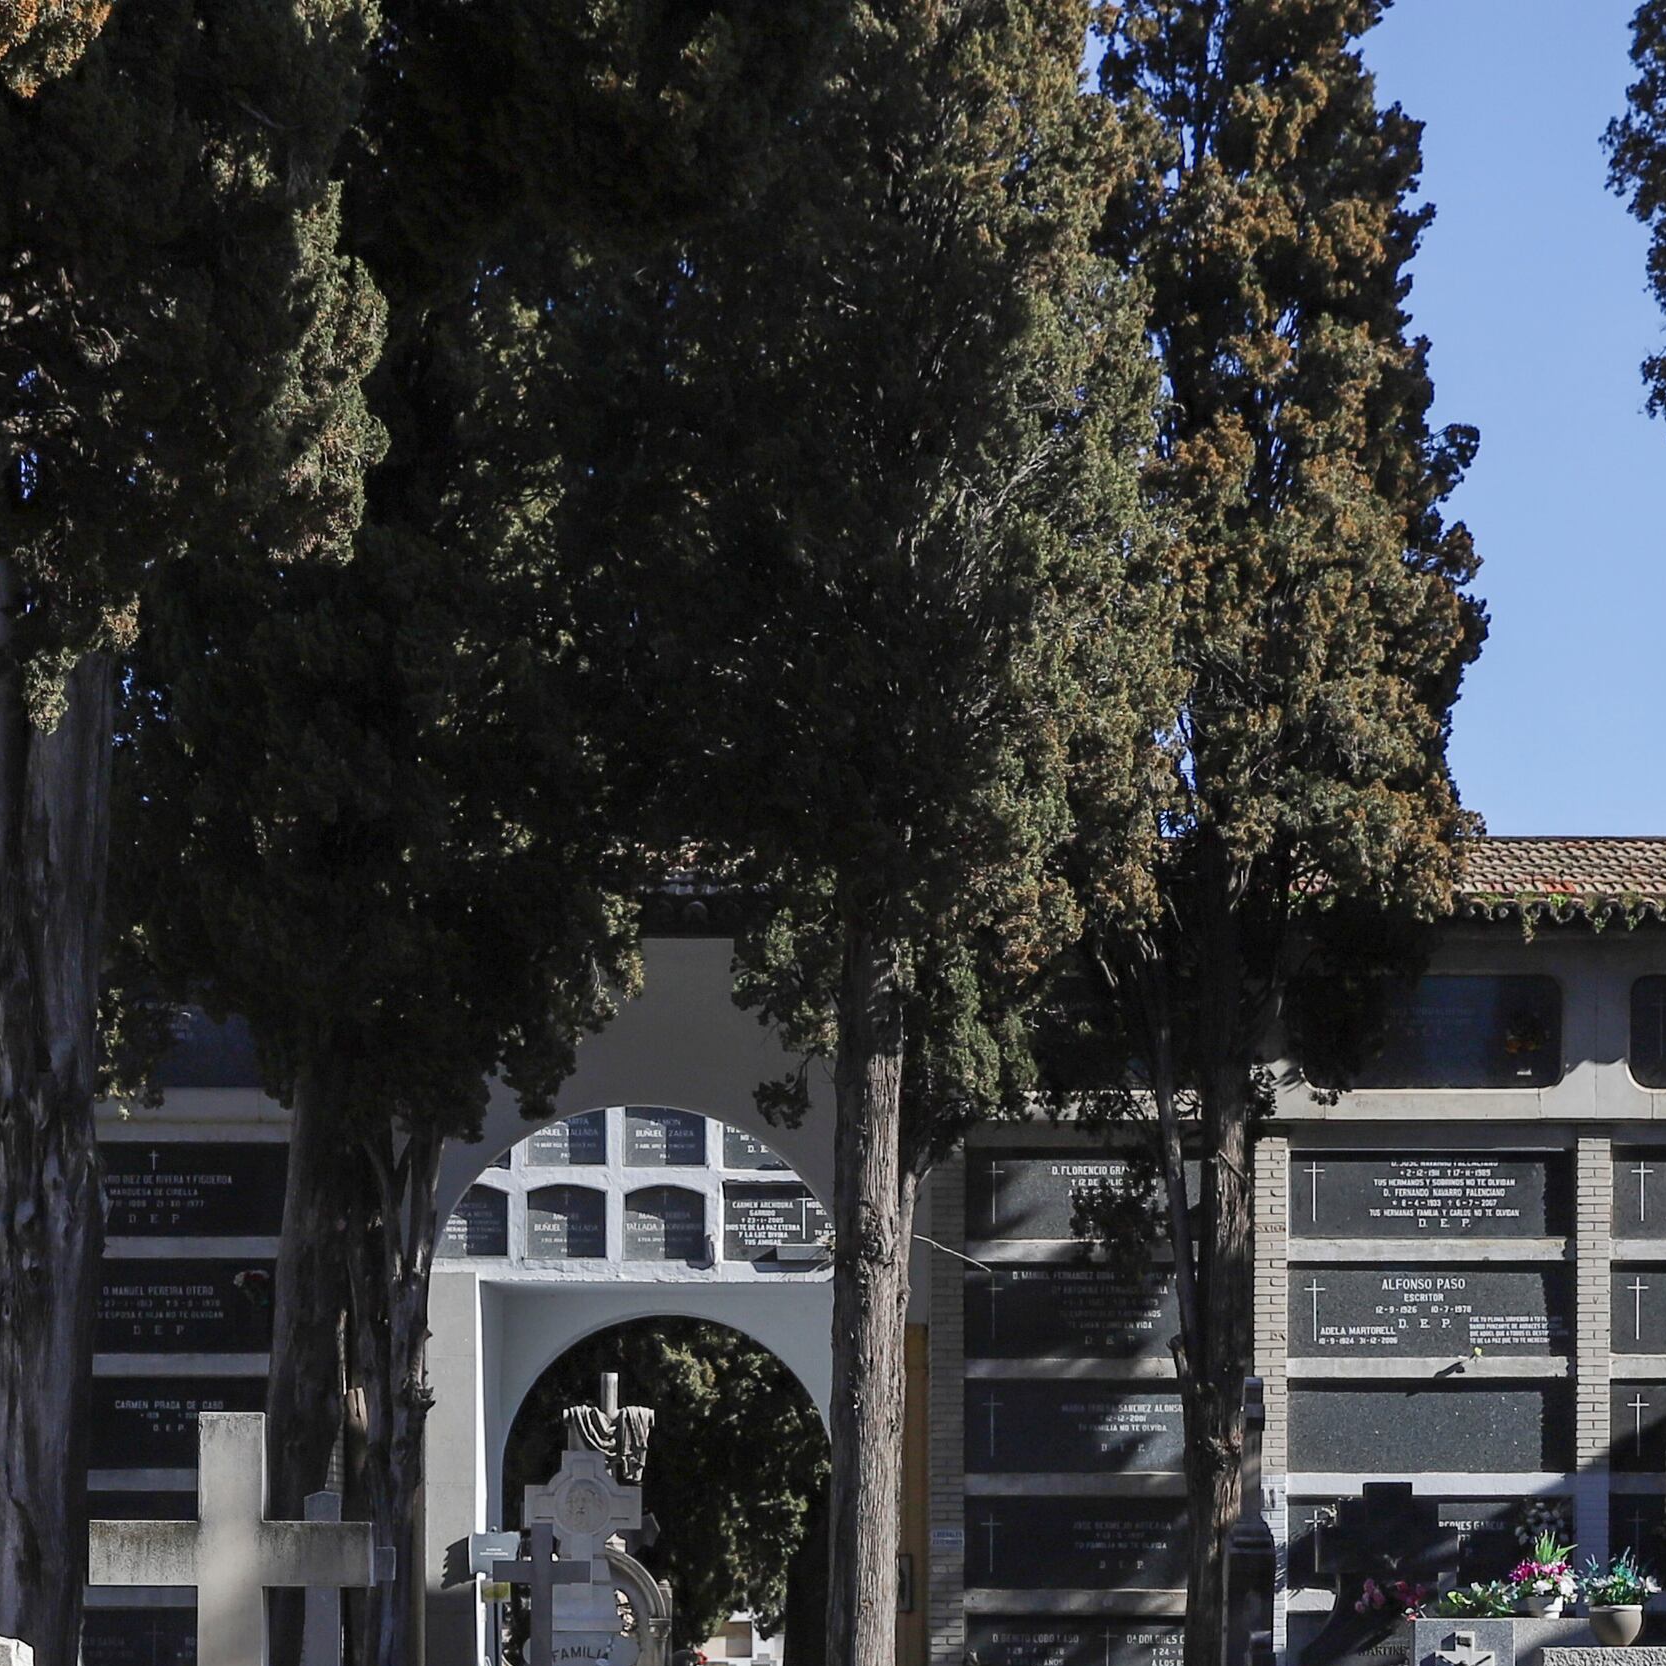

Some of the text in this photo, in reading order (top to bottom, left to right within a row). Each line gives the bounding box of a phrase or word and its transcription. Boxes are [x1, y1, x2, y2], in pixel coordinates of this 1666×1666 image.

[1052, 1166, 1107, 1175] D. FLORENCIO
[143, 1175, 154, 1184] DE
[156, 1175, 184, 1184] RIVERA
[193, 1175, 232, 1184] FIGUEROA
[1383, 1188, 1505, 1197] D. FERNANDO NAVARRO PALENCIANO
[1369, 1209, 1519, 1217] TUS HERMANAS FAMILIA Y CARLOS NO TE OLVIDAN
[534, 1223, 561, 1231] BUÑUEL
[1419, 1218, 1470, 1228] D. E. P.
[1382, 1279, 1466, 1290] ALFONSO PASO
[112, 1286, 213, 1295] MANUEL PEREIRA OTERO
[1404, 1294, 1444, 1302] ESCRITOR
[1398, 1319, 1451, 1328] D. E. P.
[1320, 1327, 1396, 1335] ADELA MARTORELL
[115, 1401, 149, 1409] CARMEN
[154, 1401, 180, 1409] PRADA
[1119, 1404, 1151, 1413] SANCHEZ
[1155, 1404, 1183, 1413] ALONSO
[552, 1646, 609, 1662] FAMILIA
